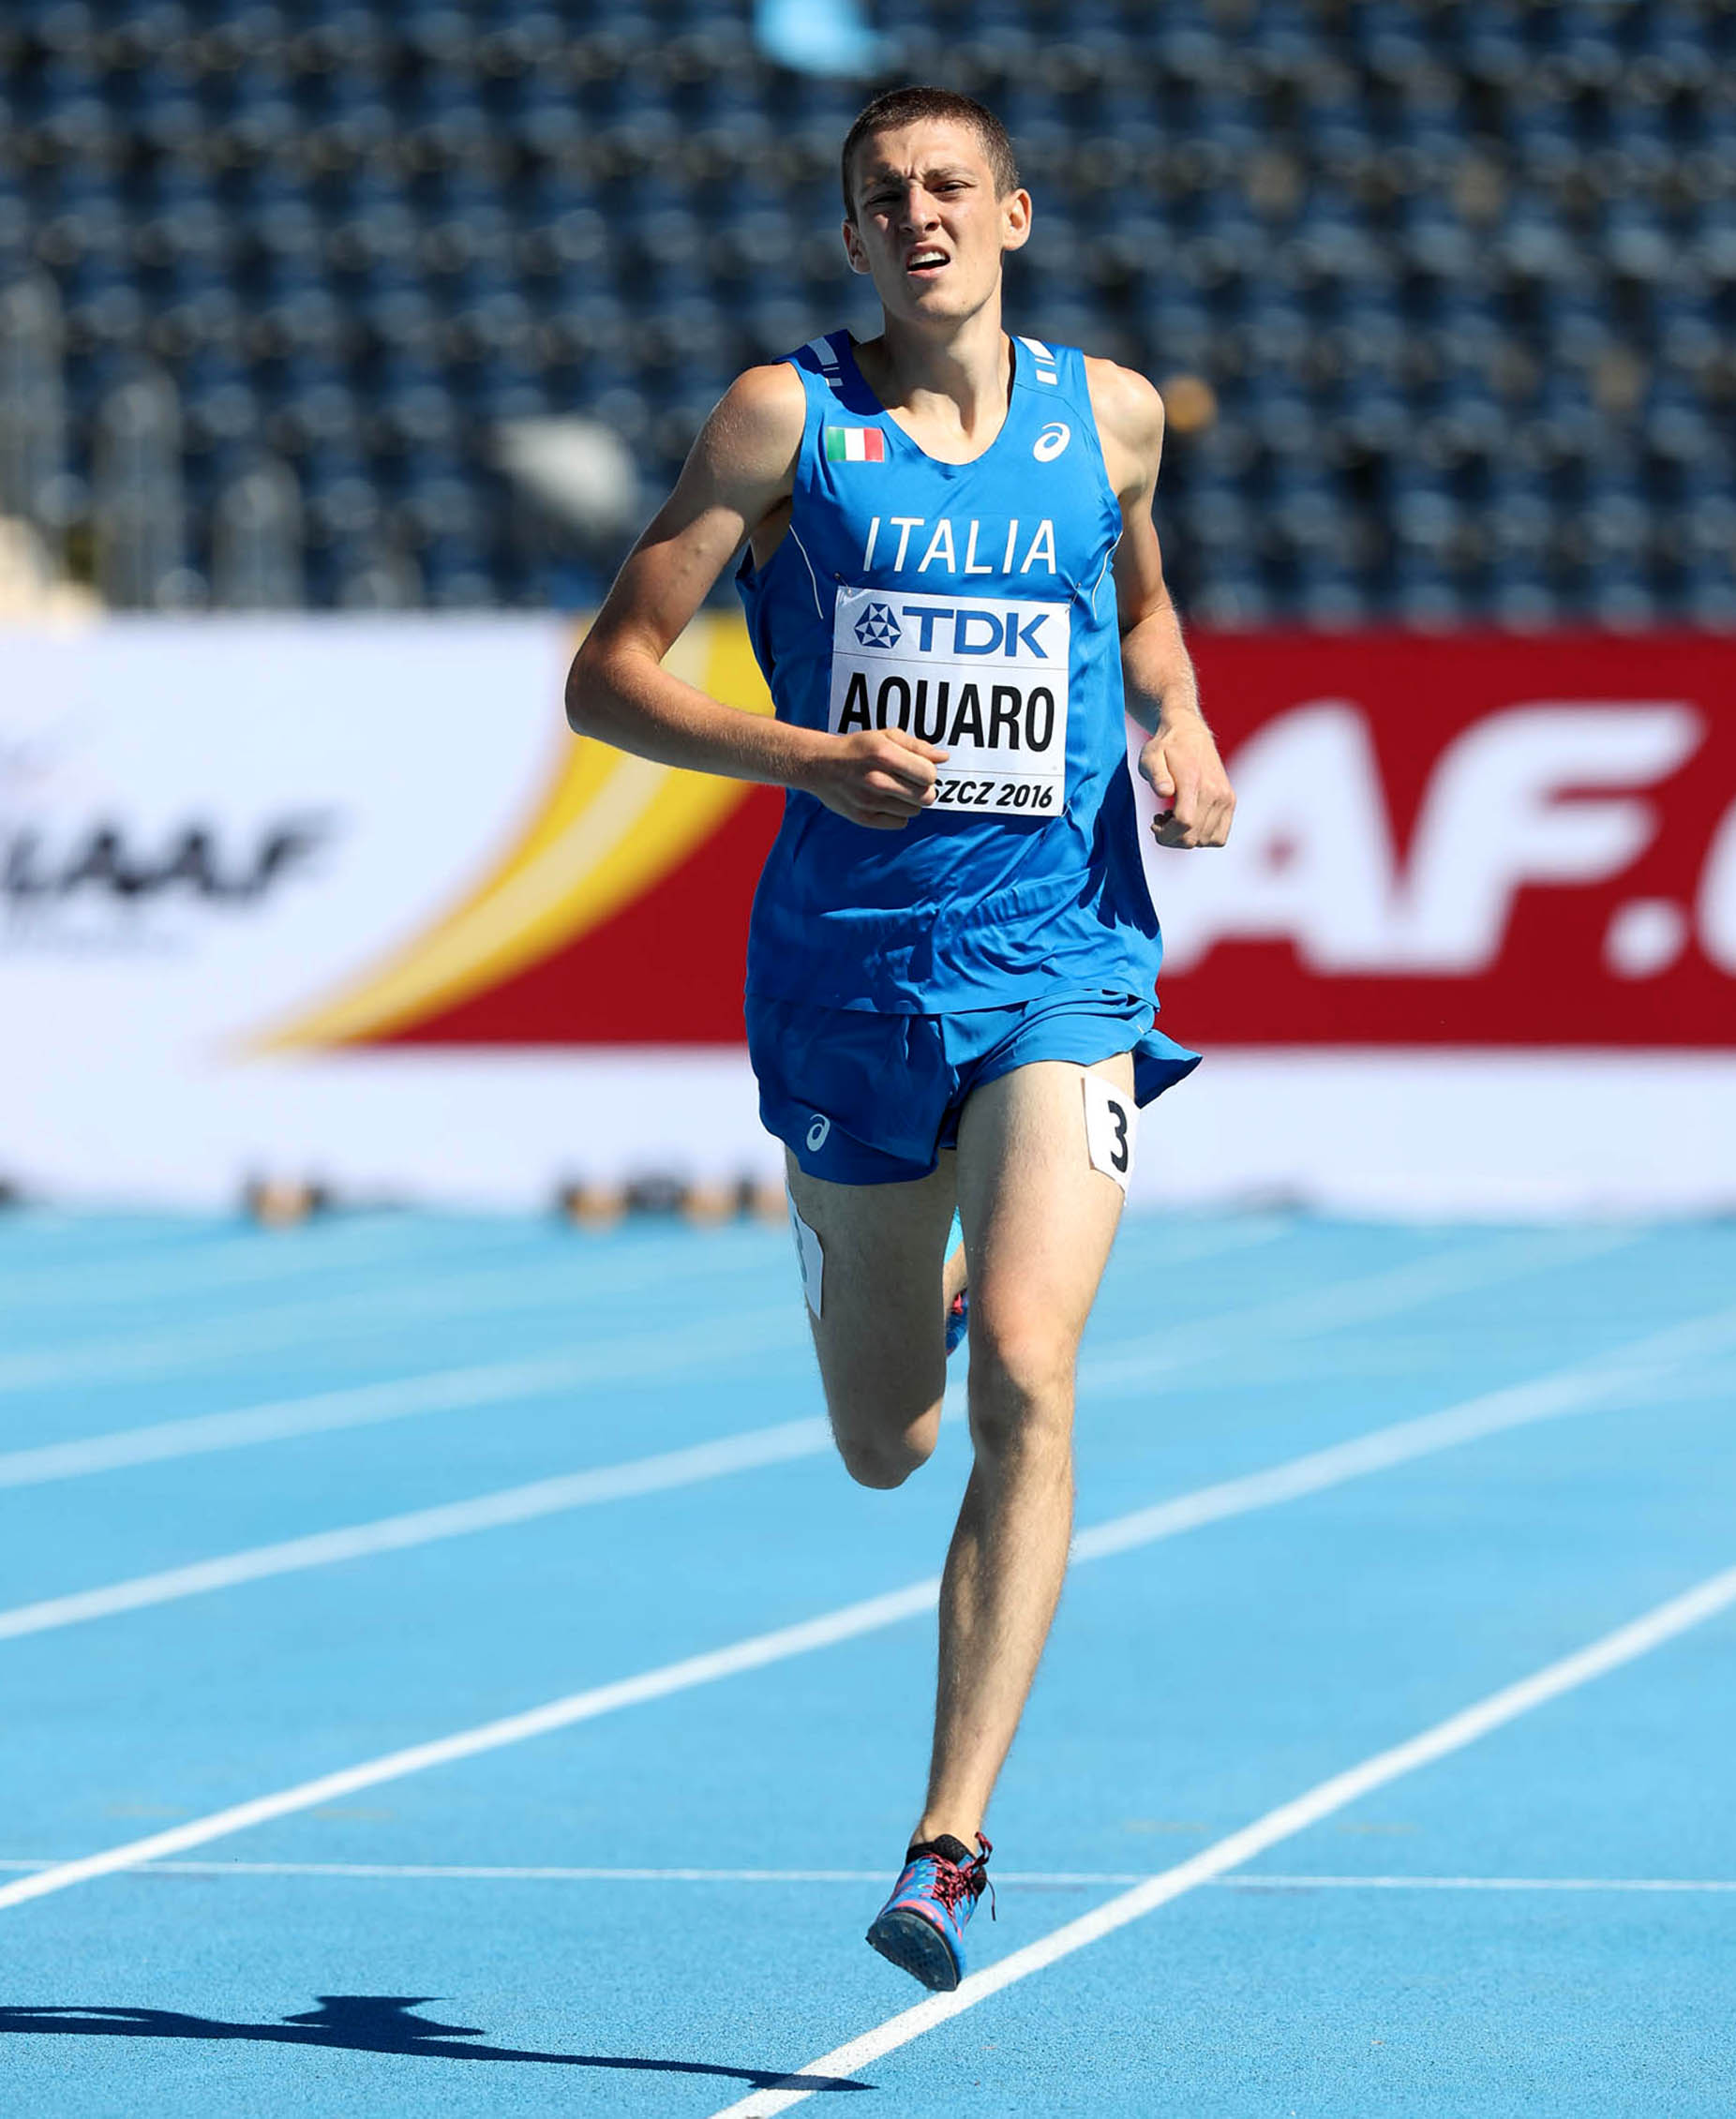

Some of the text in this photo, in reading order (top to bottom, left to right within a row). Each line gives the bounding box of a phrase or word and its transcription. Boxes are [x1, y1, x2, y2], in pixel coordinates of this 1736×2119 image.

[862, 516, 1057, 575] ITALIA
[902, 605, 1051, 659] TDK
[995, 783, 1054, 808] 2016
[1107, 1099, 1129, 1173] 3
